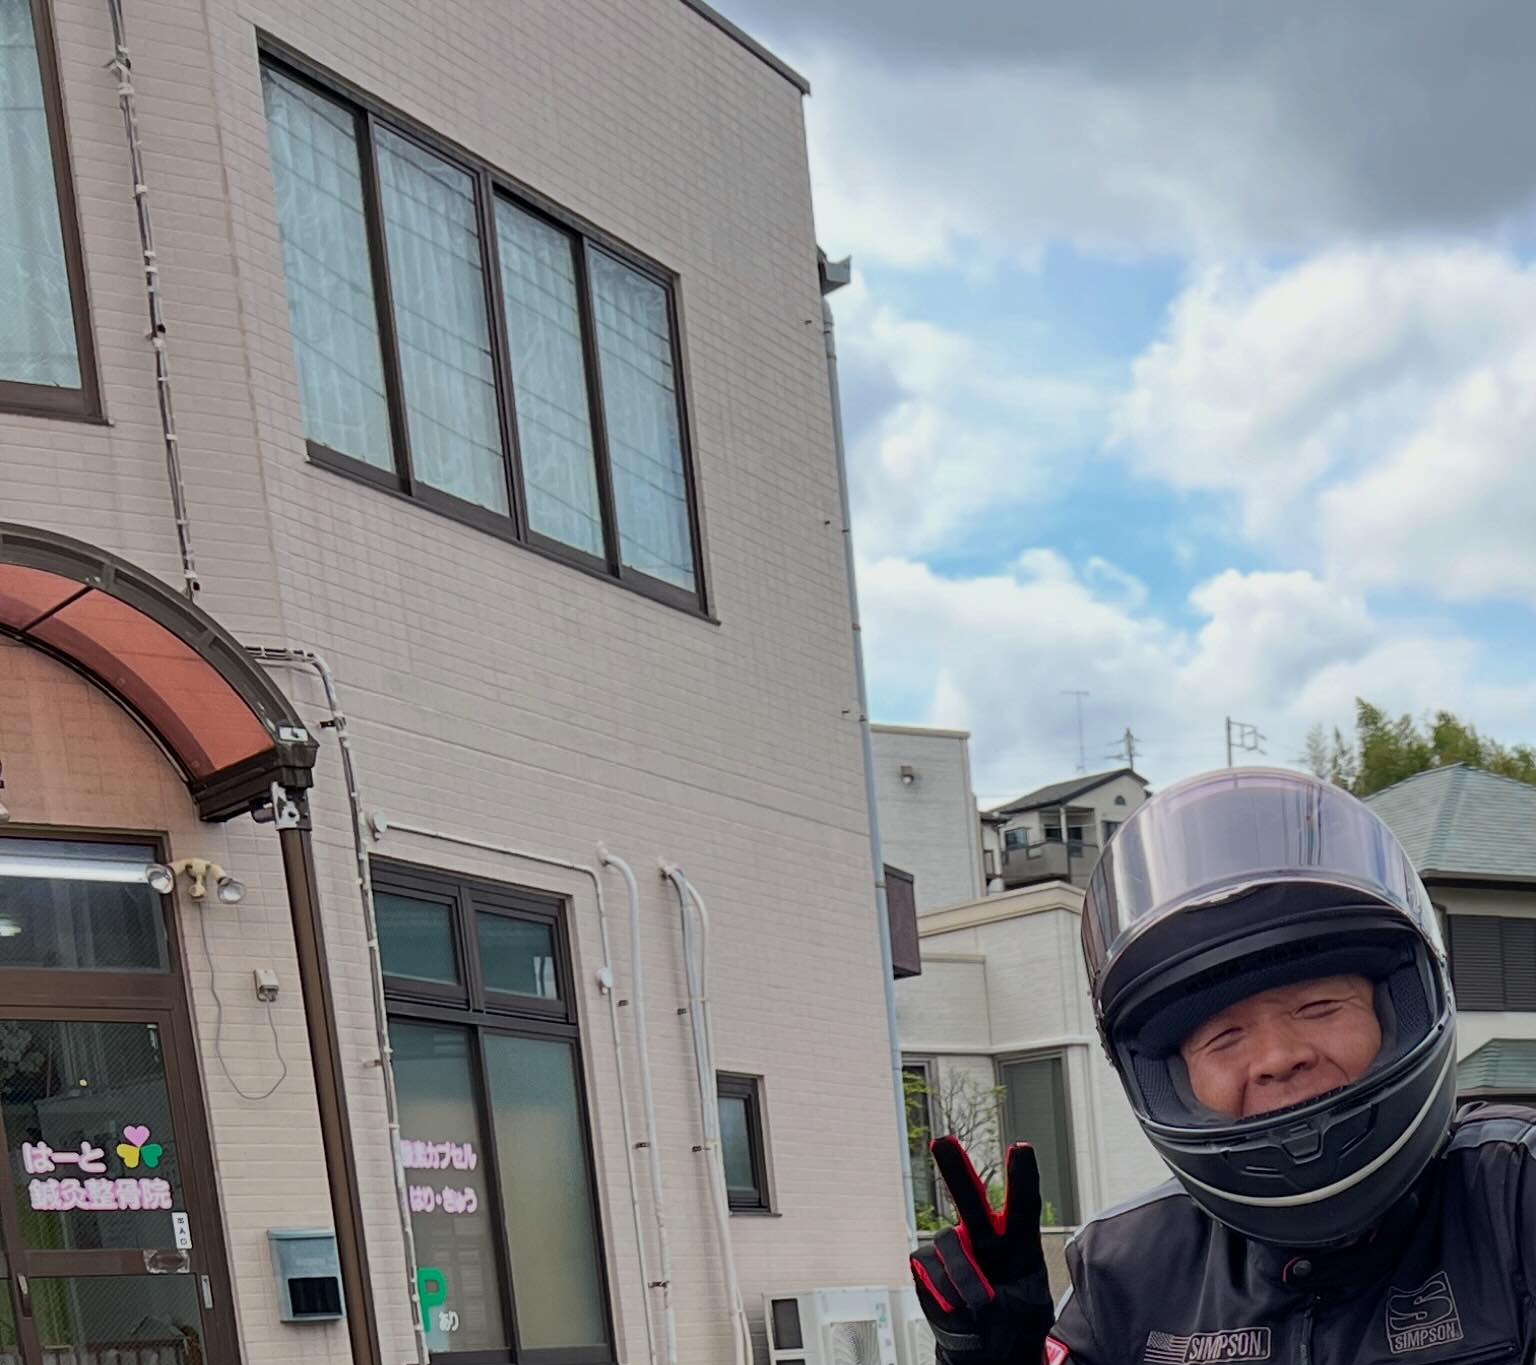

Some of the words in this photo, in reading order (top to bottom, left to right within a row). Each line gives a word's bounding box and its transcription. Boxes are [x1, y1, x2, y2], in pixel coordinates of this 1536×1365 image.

[22, 1141, 107, 1174] はーと
[1188, 1330, 1263, 1361] SIMPSON
[1394, 1322, 1457, 1350] SIMPSON
